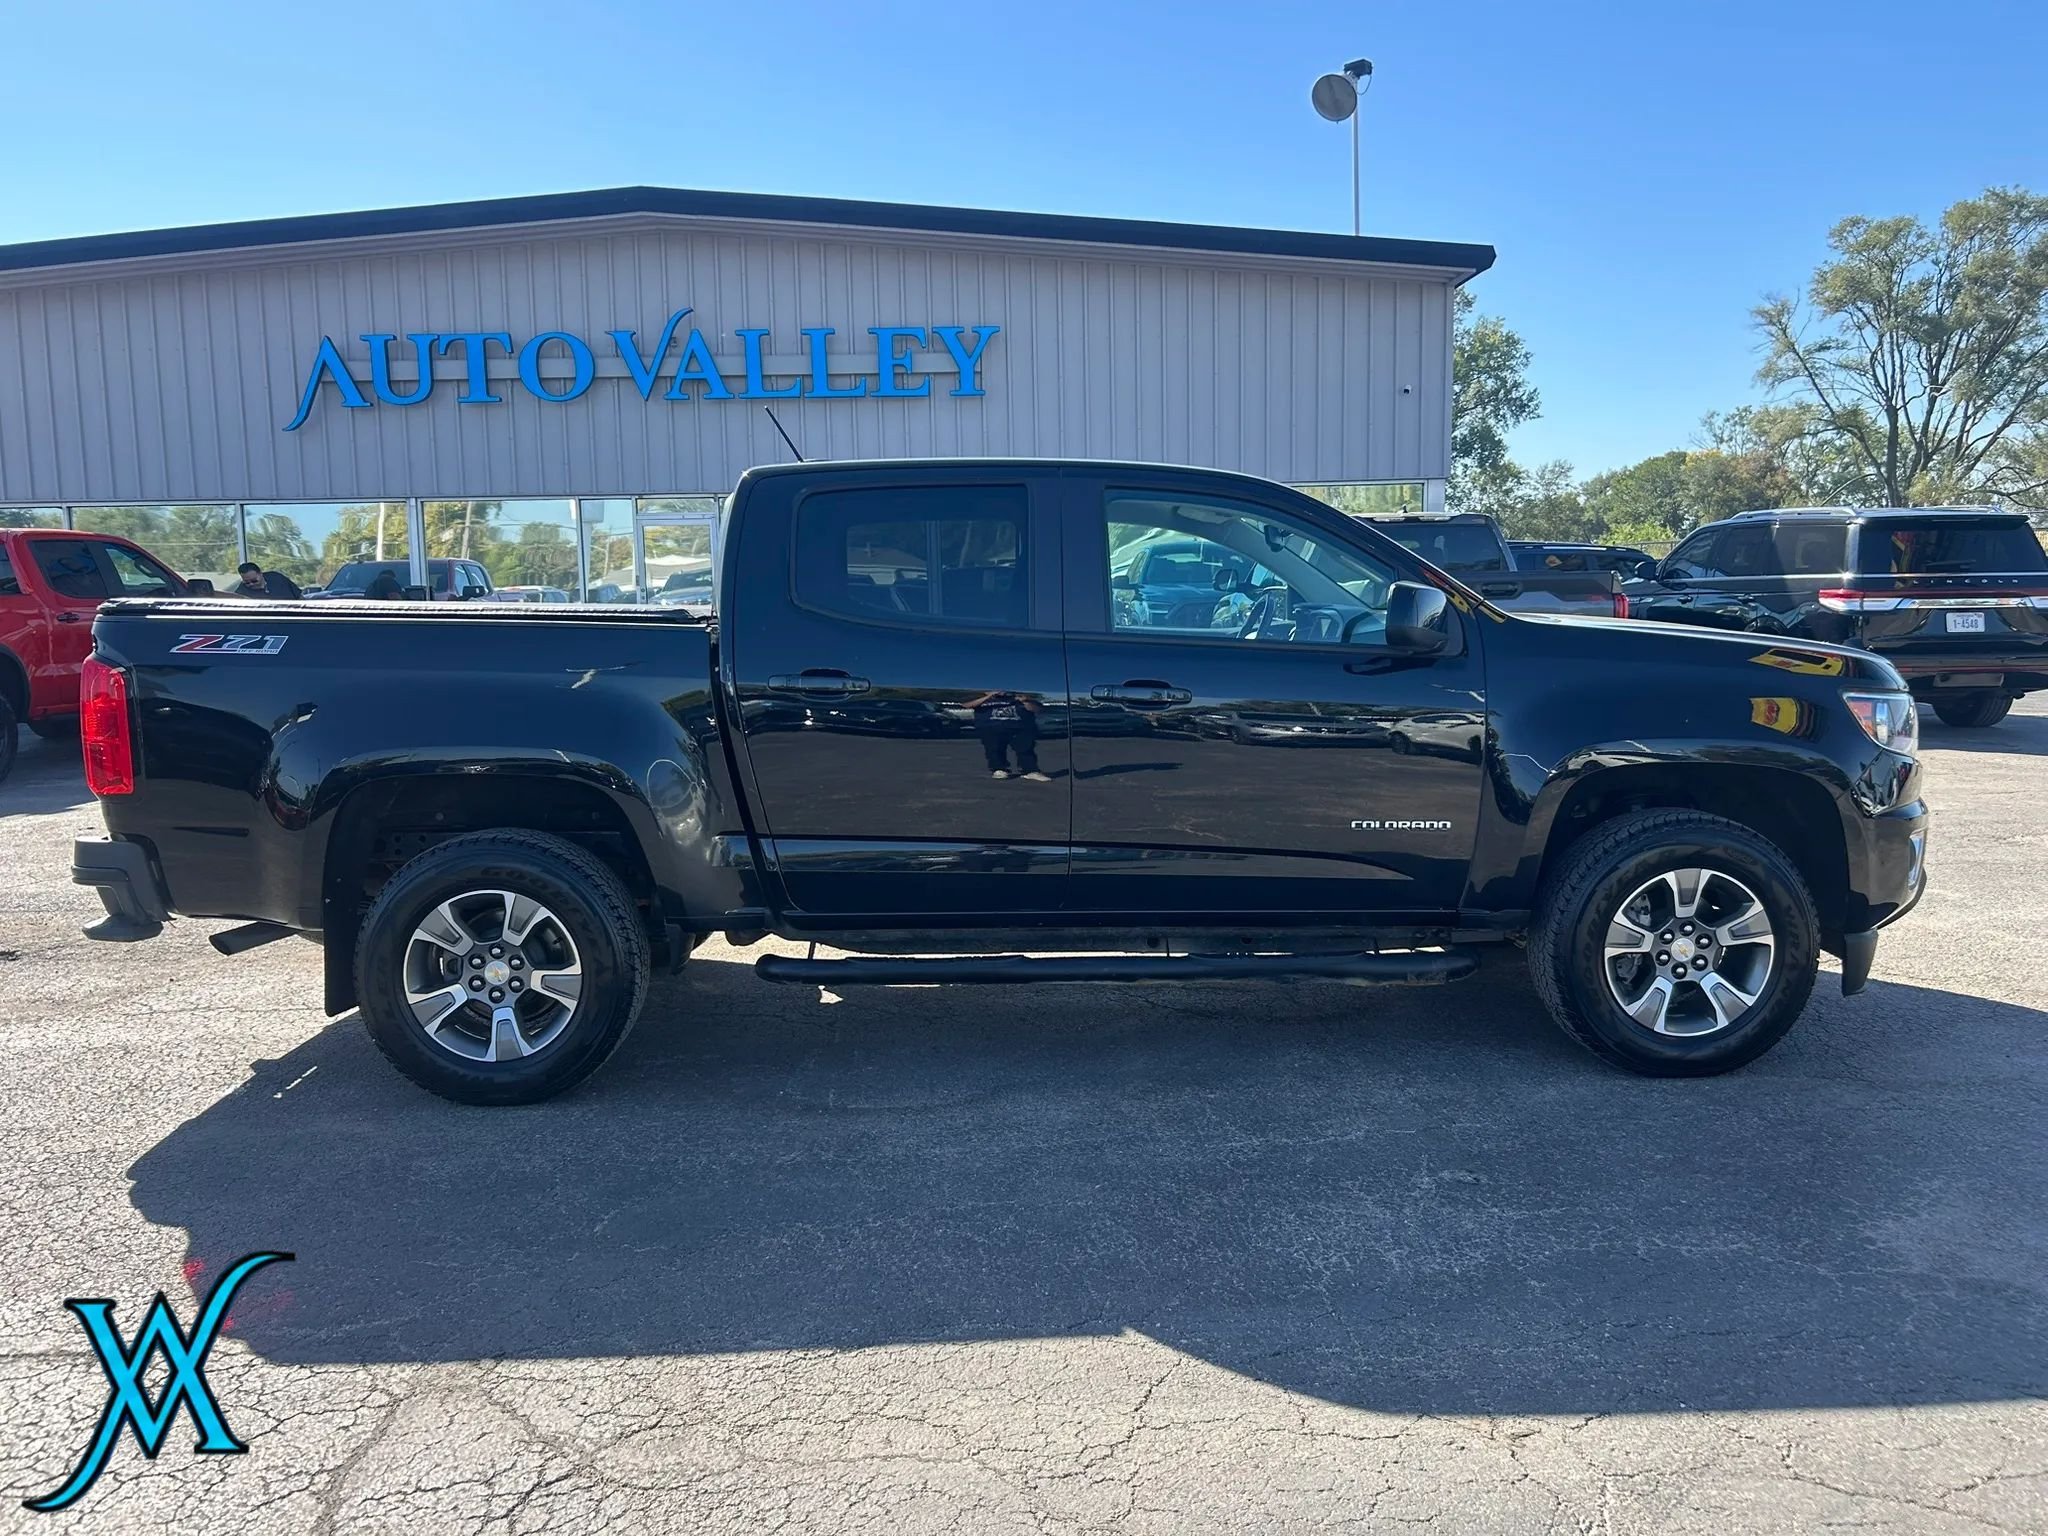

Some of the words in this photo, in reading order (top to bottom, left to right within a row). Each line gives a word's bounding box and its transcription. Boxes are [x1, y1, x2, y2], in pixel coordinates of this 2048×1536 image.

[282, 331, 595, 431] AUTO
[605, 307, 1001, 401] VALLEY
[169, 634, 289, 655] Z71
[1351, 820, 1452, 831] COLORADO
